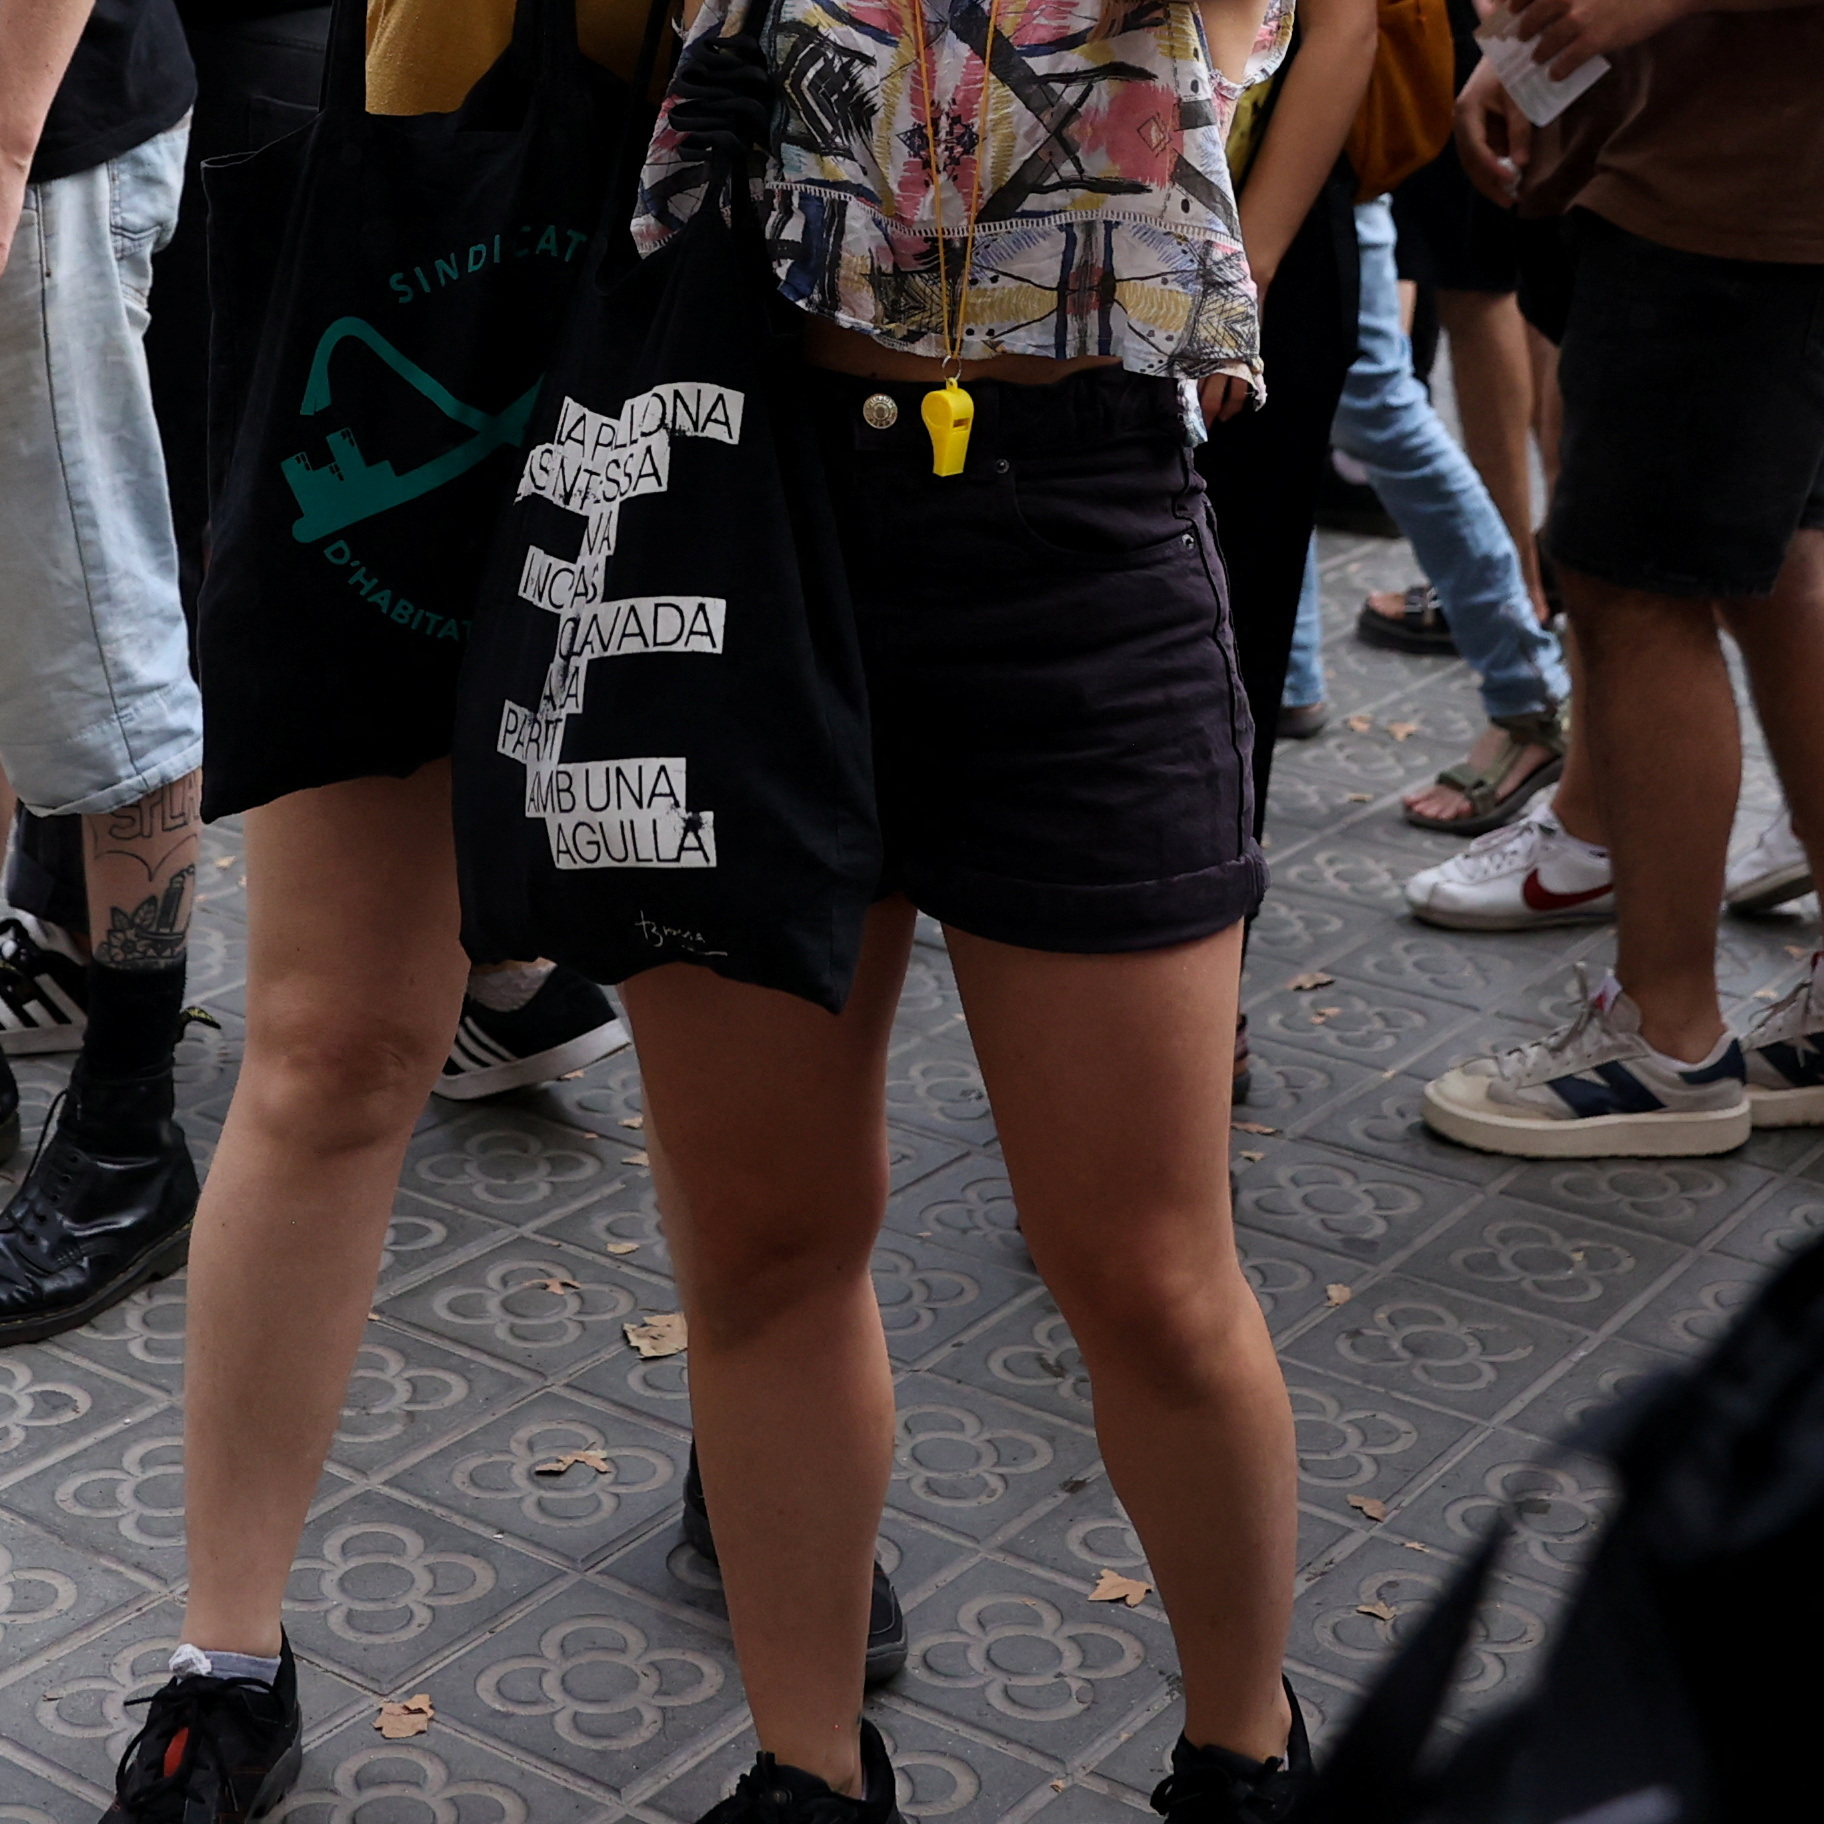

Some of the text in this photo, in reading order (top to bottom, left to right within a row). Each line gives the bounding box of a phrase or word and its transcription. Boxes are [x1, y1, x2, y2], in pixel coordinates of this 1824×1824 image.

[389, 224, 589, 305] SINDICAT
[527, 765, 680, 813] AMB UNA
[555, 816, 711, 865] AGULLA
